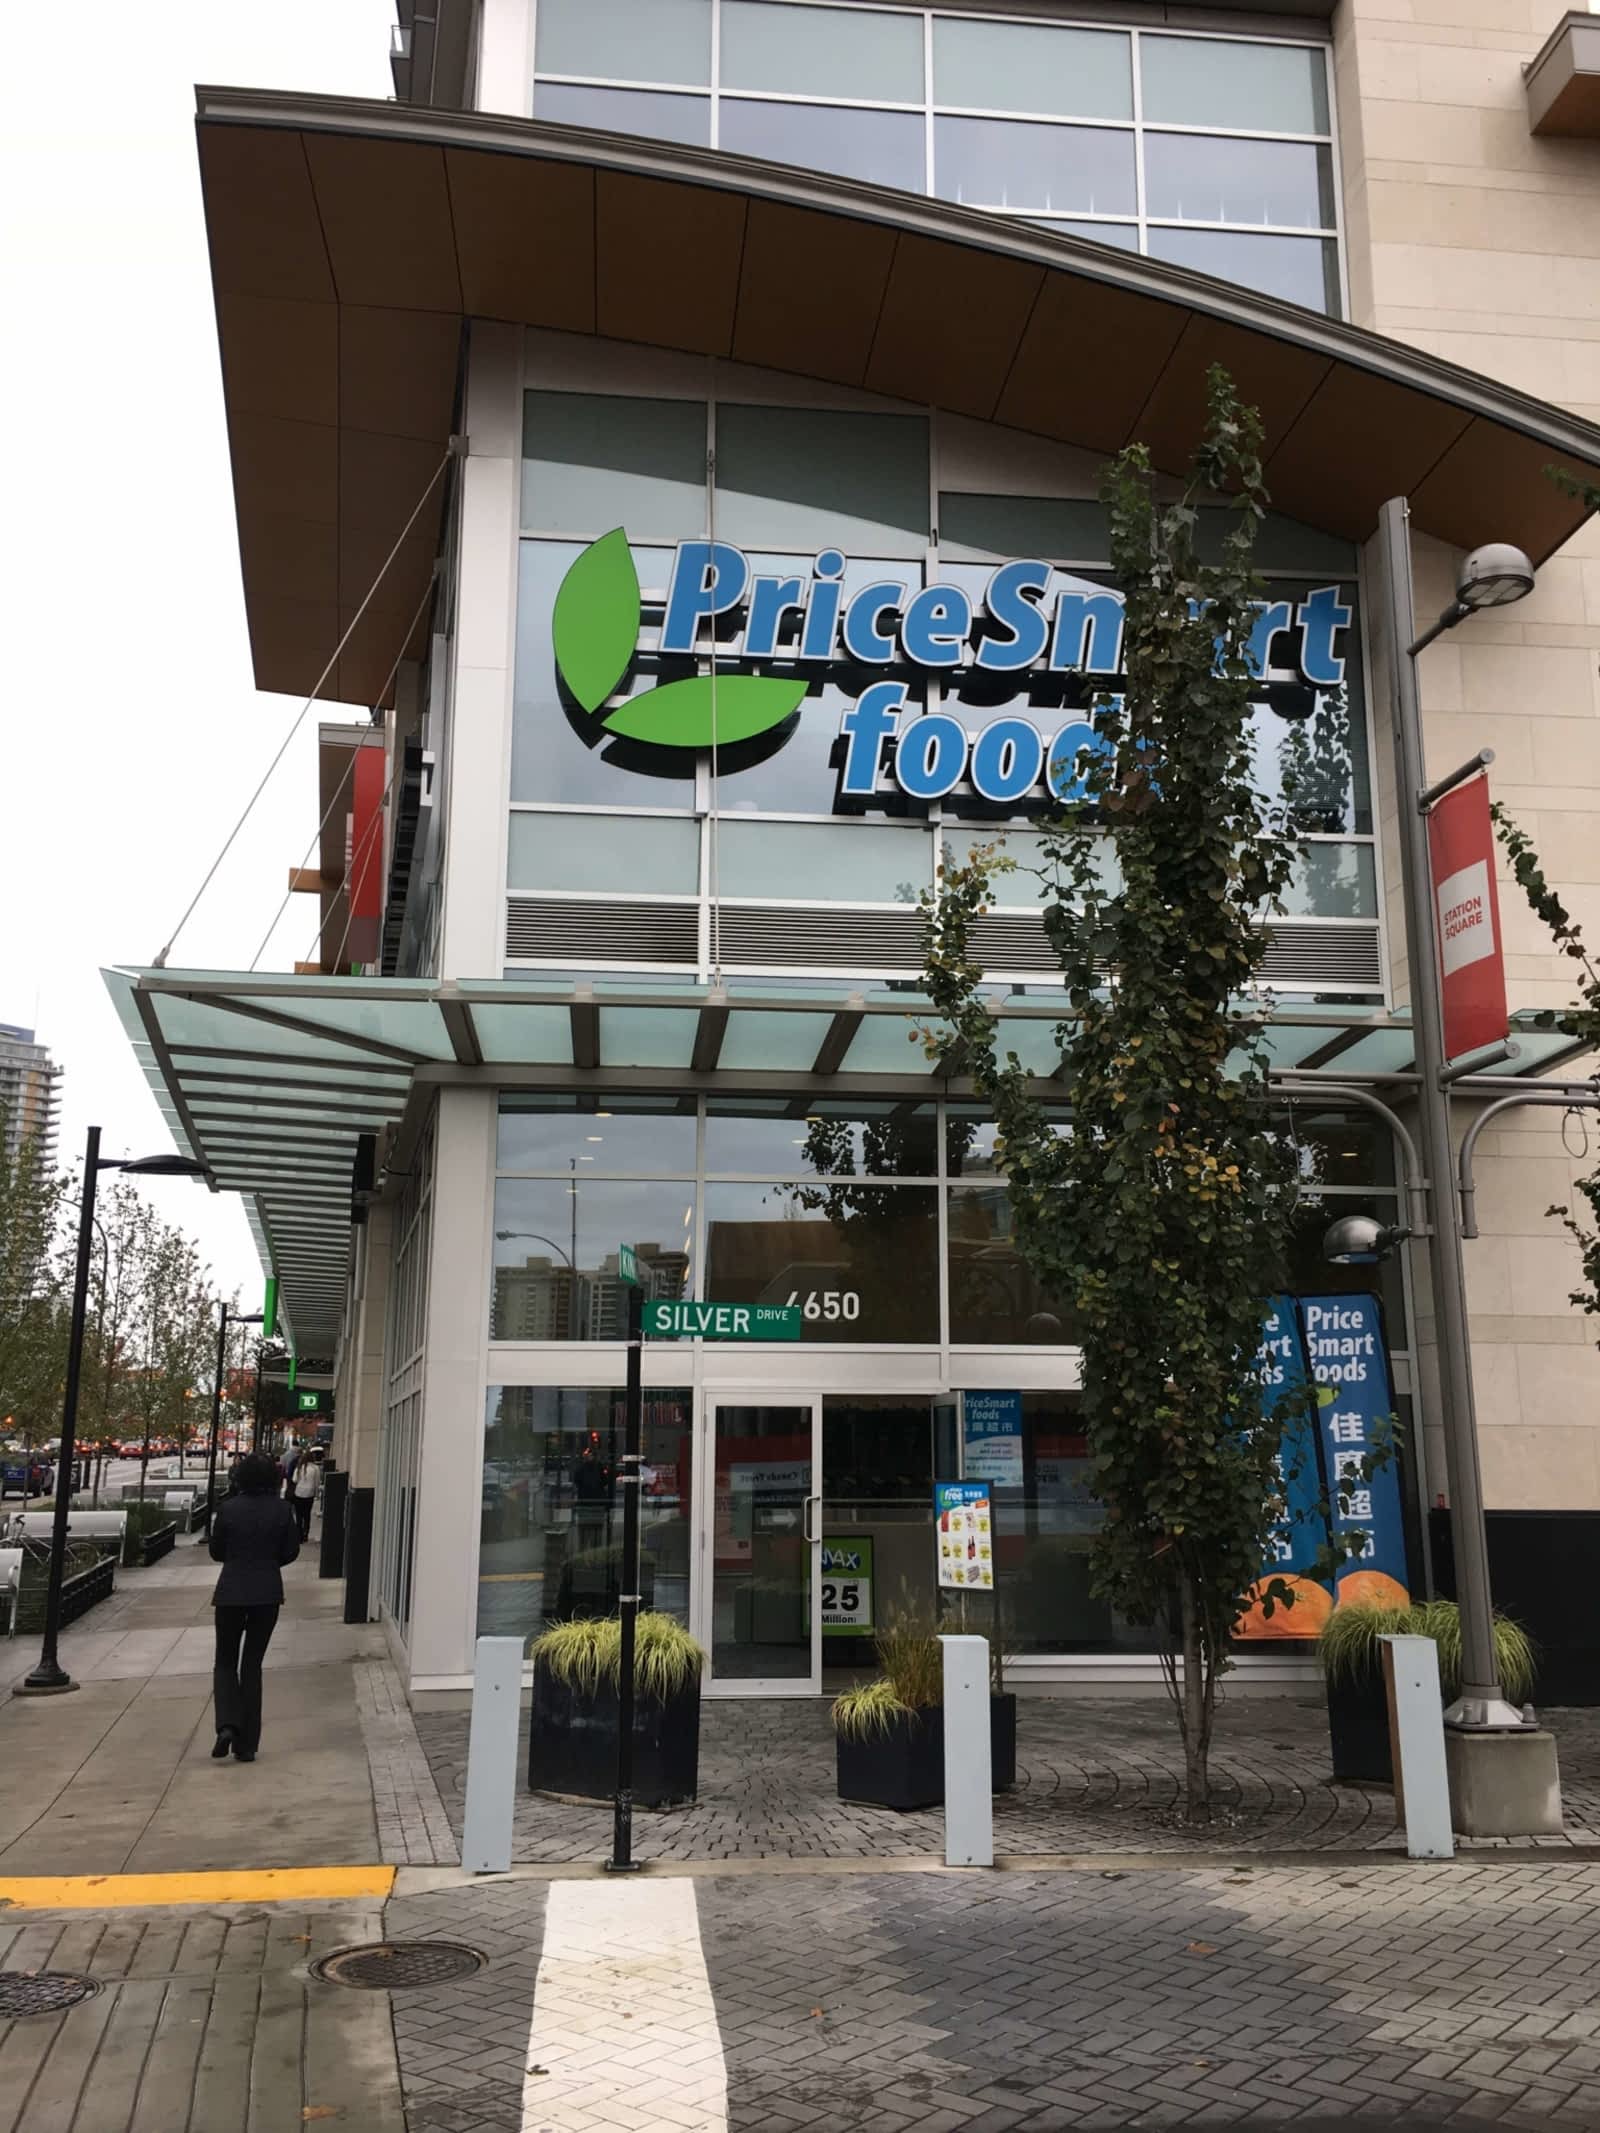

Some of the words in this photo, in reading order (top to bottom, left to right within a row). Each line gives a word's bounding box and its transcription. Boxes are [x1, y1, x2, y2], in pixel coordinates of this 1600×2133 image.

[660, 539, 1353, 686] PriceSmrt
[840, 680, 1165, 803] food
[1443, 896, 1481, 925] STATION
[1445, 911, 1483, 940] SQUARE
[655, 1304, 750, 1333] SILVER
[756, 1309, 789, 1321] DRIVE
[1306, 1305, 1364, 1331] Price
[1306, 1331, 1375, 1358] Smart
[301, 1396, 316, 1406] TD
[965, 1396, 1015, 1409] riceSmart
[971, 1409, 1000, 1420] foods
